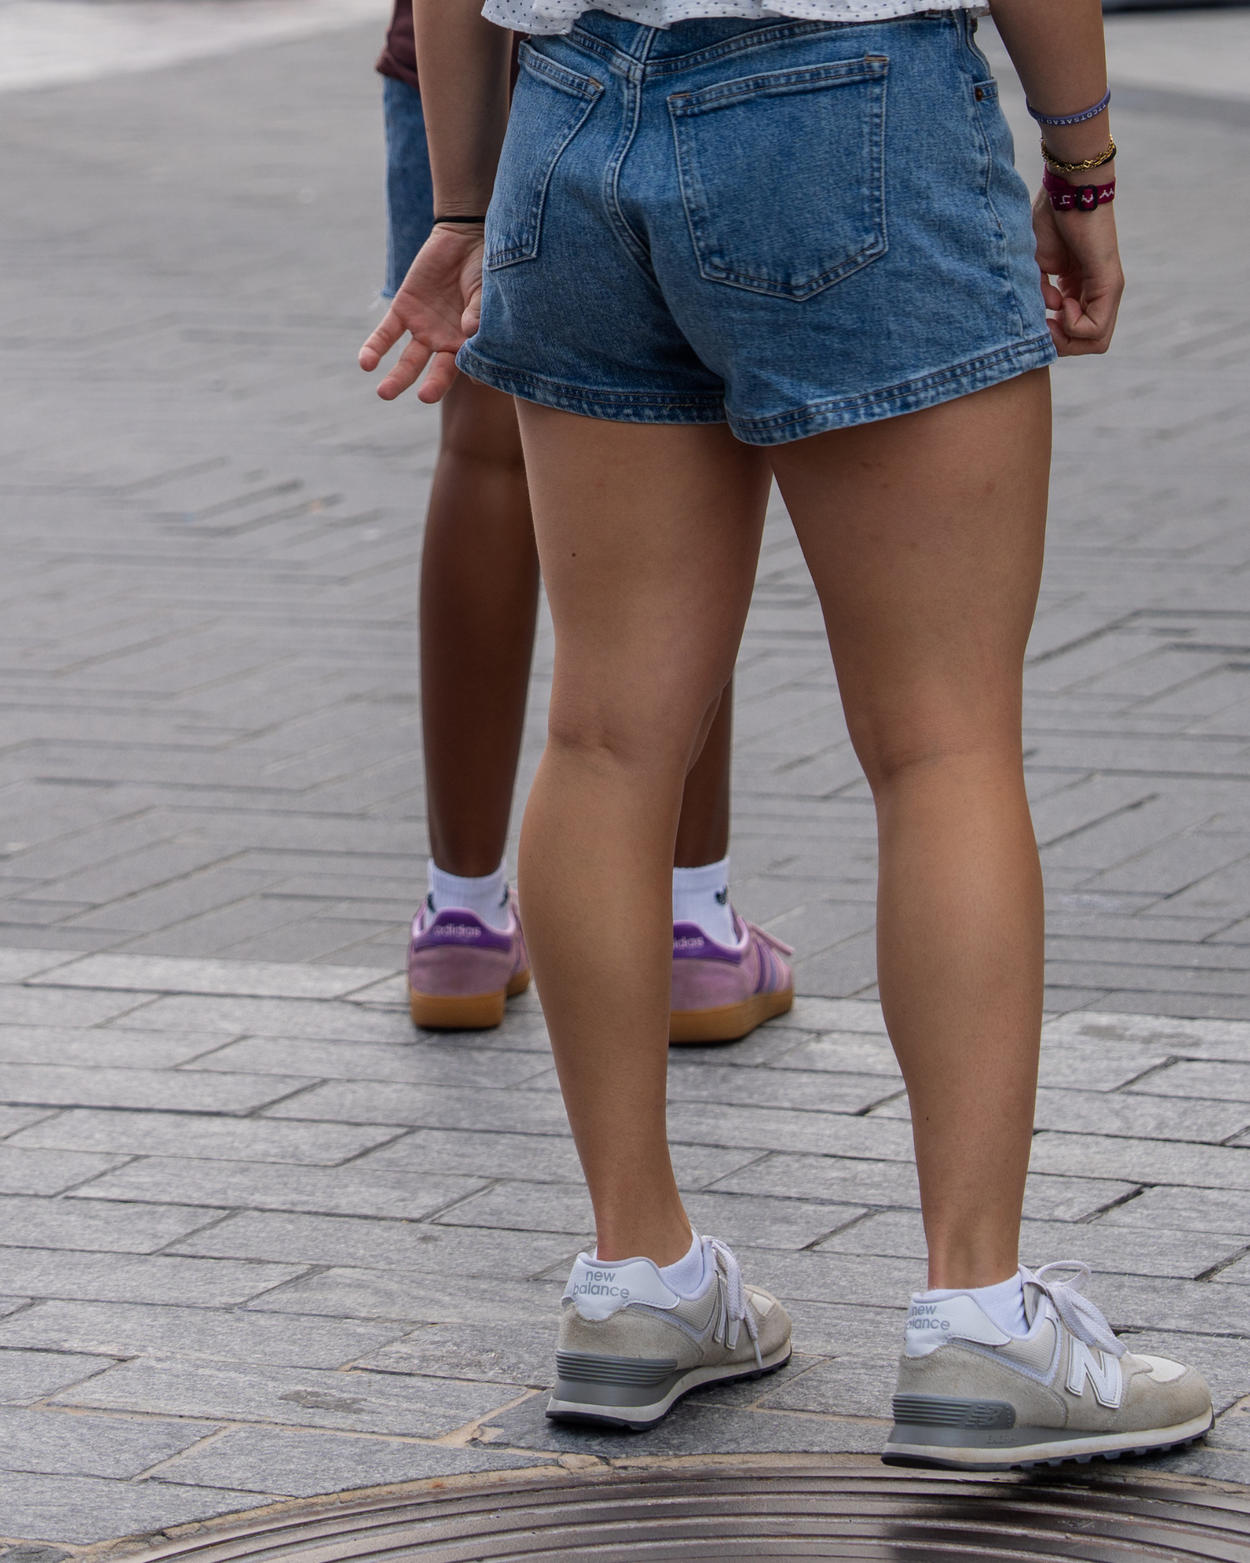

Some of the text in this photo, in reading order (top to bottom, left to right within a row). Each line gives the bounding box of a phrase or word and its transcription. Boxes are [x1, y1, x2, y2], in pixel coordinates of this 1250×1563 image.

[433, 923, 482, 938] adidas
[673, 936, 705, 949] idas
[586, 1270, 616, 1281] new
[573, 1281, 630, 1298] balance
[911, 1305, 937, 1316] new
[905, 1317, 951, 1331] alance
